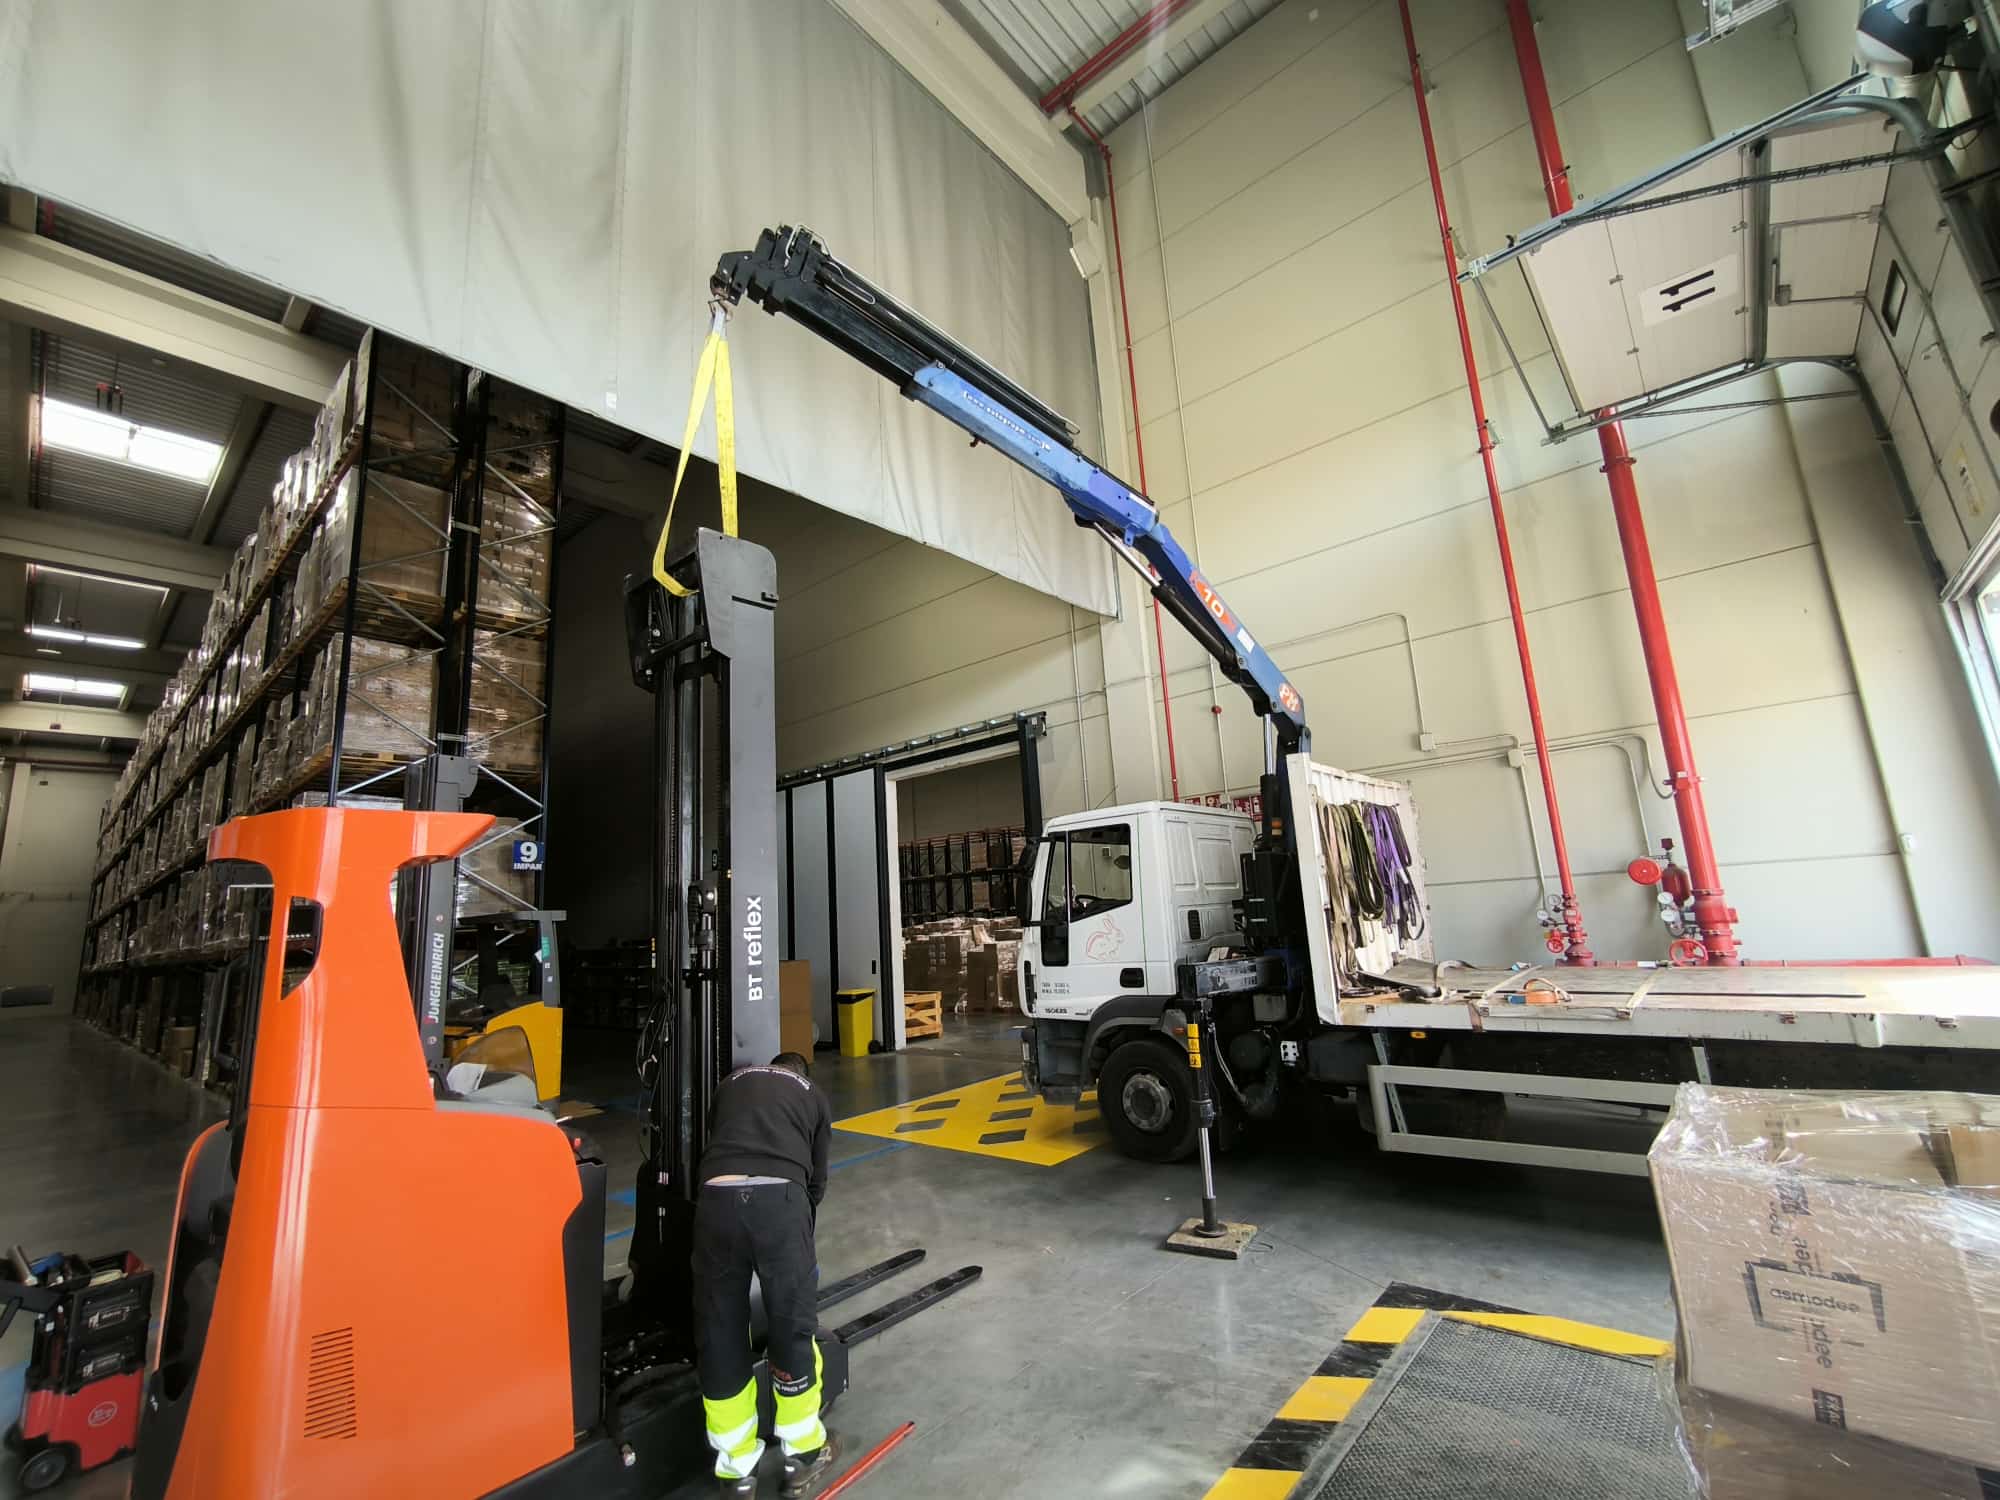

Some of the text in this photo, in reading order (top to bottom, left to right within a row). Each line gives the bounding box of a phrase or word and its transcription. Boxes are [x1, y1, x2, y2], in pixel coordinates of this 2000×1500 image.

[1202, 588, 1225, 618] 10
[520, 841, 538, 863] 9
[743, 896, 763, 1001] BT reflex
[427, 932, 445, 1024] JUNGHEINRICH
[1769, 1287, 1860, 1313] asmodee
